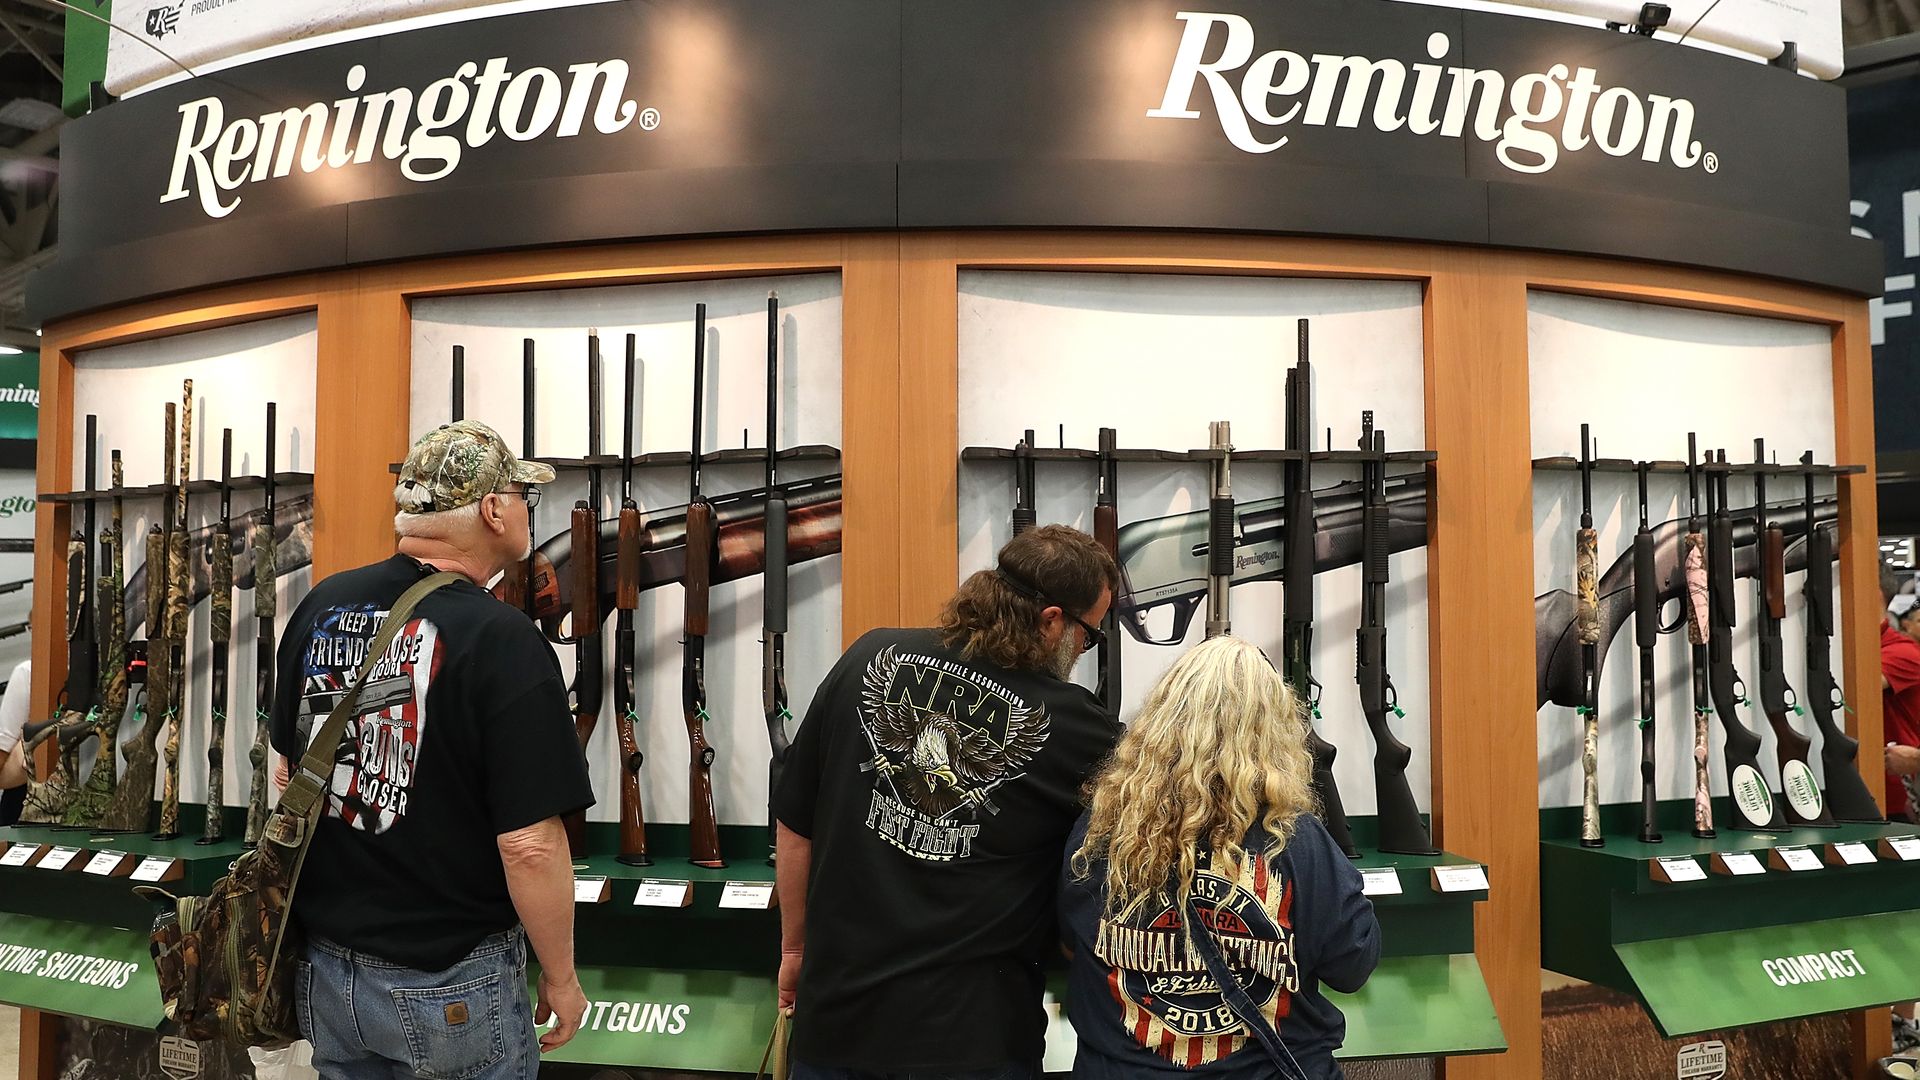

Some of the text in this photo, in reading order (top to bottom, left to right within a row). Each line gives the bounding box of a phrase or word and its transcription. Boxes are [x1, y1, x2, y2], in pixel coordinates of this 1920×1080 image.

[338, 611, 368, 633] KEEP
[372, 662, 400, 680] YOUR
[899, 653, 1024, 708] NATIONAL RIFLE ASSOCIATION
[883, 662, 1012, 750] NRA
[361, 722, 413, 788] GUNS
[357, 769, 407, 816] CLOSER
[865, 789, 980, 858] FIST FIGHT
[885, 796, 959, 828] BECAUSE YOU CAN'T
[878, 831, 954, 862] TYRANNY
[37, 951, 139, 989] SHOTGUNS
[1094, 918, 1300, 993] ANNUAL METINGS
[1761, 949, 1866, 987] COMPACT
[533, 1000, 690, 1035] TGUNS
[1164, 1007, 1235, 1033] 2018
[162, 1047, 197, 1064] LIFETIME
[1680, 1052, 1723, 1069] LIFETIME
